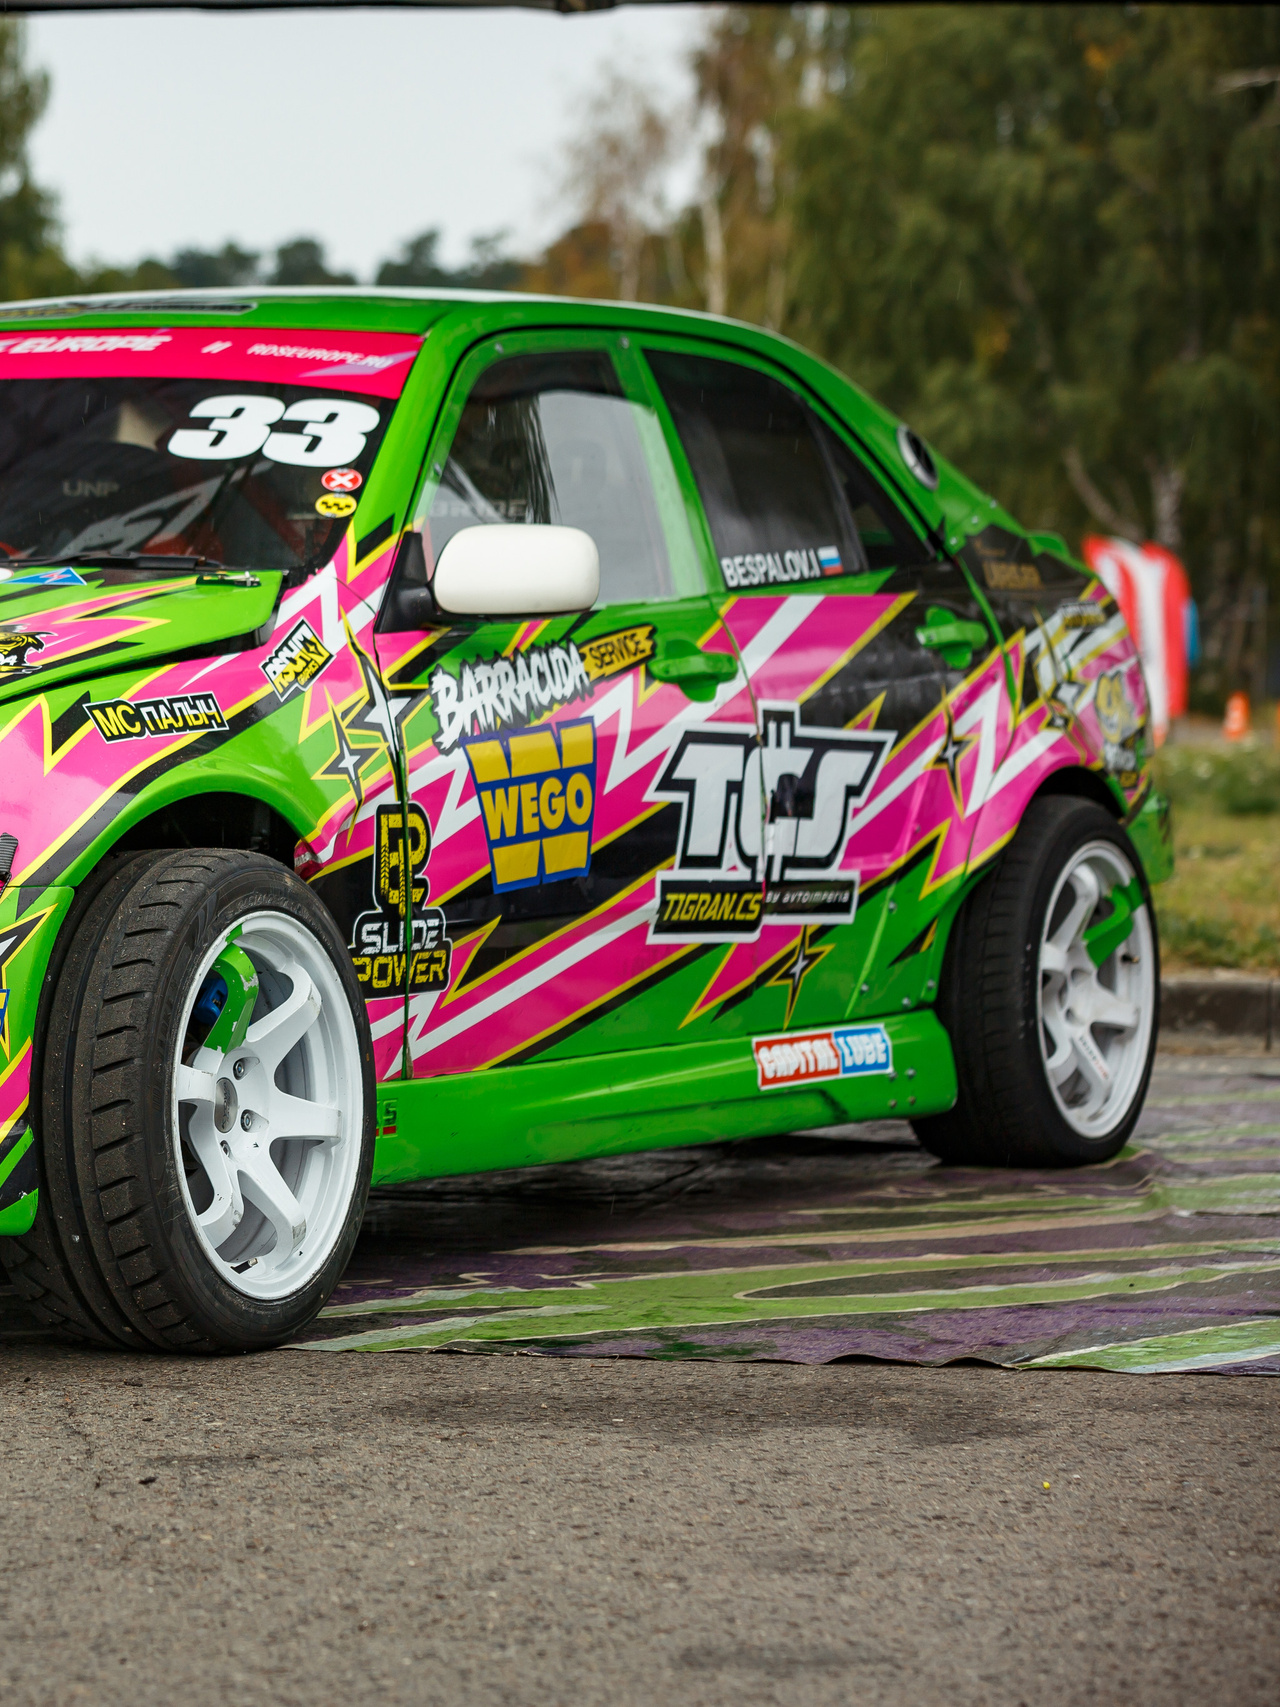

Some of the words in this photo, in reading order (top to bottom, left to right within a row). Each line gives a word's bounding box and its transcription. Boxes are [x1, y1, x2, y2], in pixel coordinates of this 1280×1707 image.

[9, 336, 172, 354] EUROPE
[168, 395, 380, 467] 33
[429, 499, 528, 518] BRDE
[720, 547, 821, 588] BESPALOV.I
[431, 642, 590, 750] BARRACUDA
[589, 632, 646, 669] SERVICE
[140, 698, 222, 731] ПАЛЫЧ
[480, 772, 593, 841] WEGO
[663, 892, 763, 921] TIGRAN.CS
[360, 918, 440, 955] SLIDE
[352, 949, 447, 989] POWER
[759, 1038, 838, 1079] CAPITAL
[837, 1033, 888, 1067] LUBE
